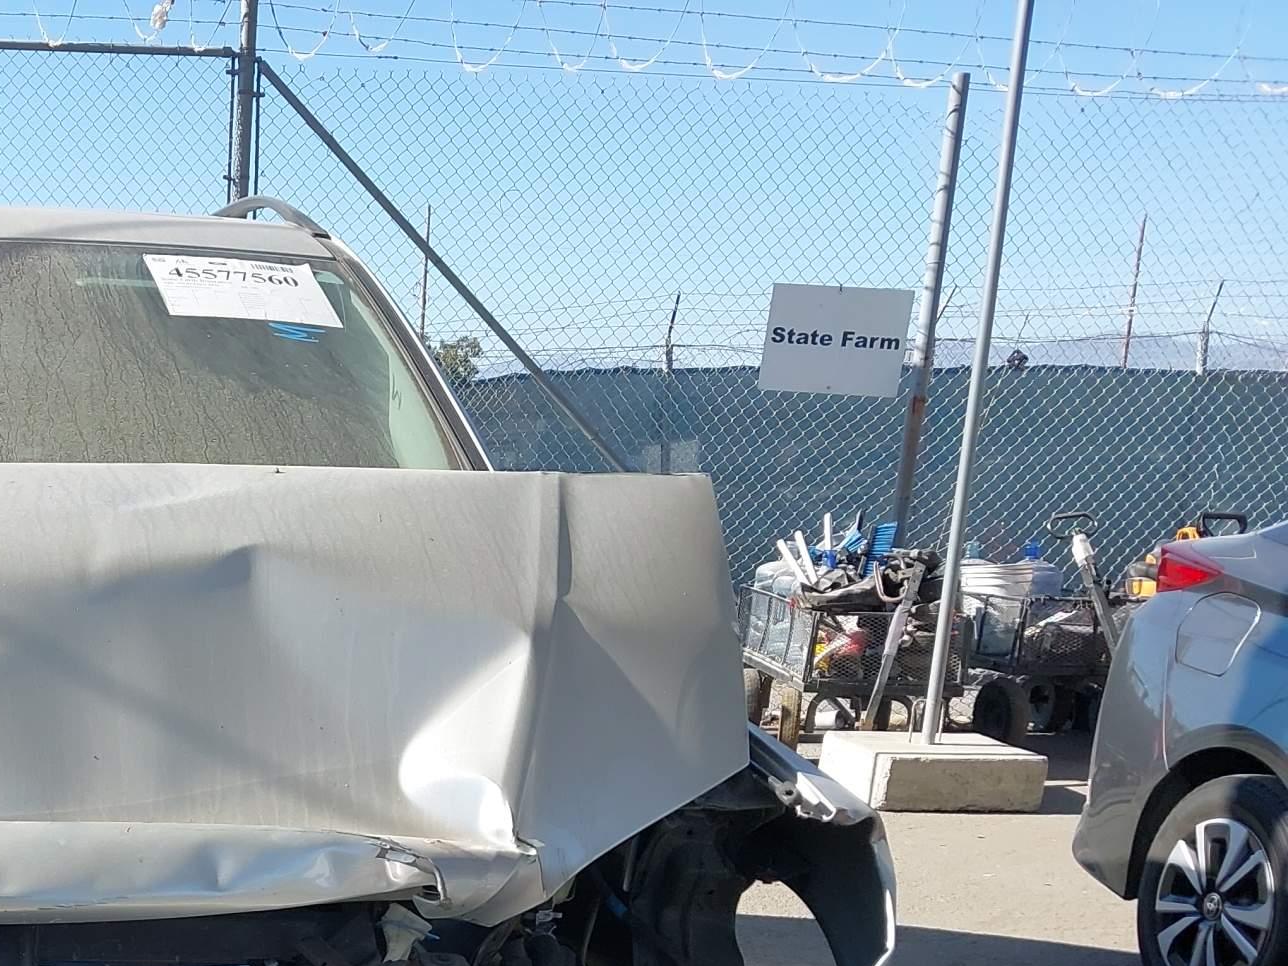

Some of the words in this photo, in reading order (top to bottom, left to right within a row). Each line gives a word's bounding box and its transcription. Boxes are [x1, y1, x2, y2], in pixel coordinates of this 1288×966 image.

[168, 267, 299, 288] 45577560
[771, 326, 833, 346] State
[841, 331, 900, 350] Farm
